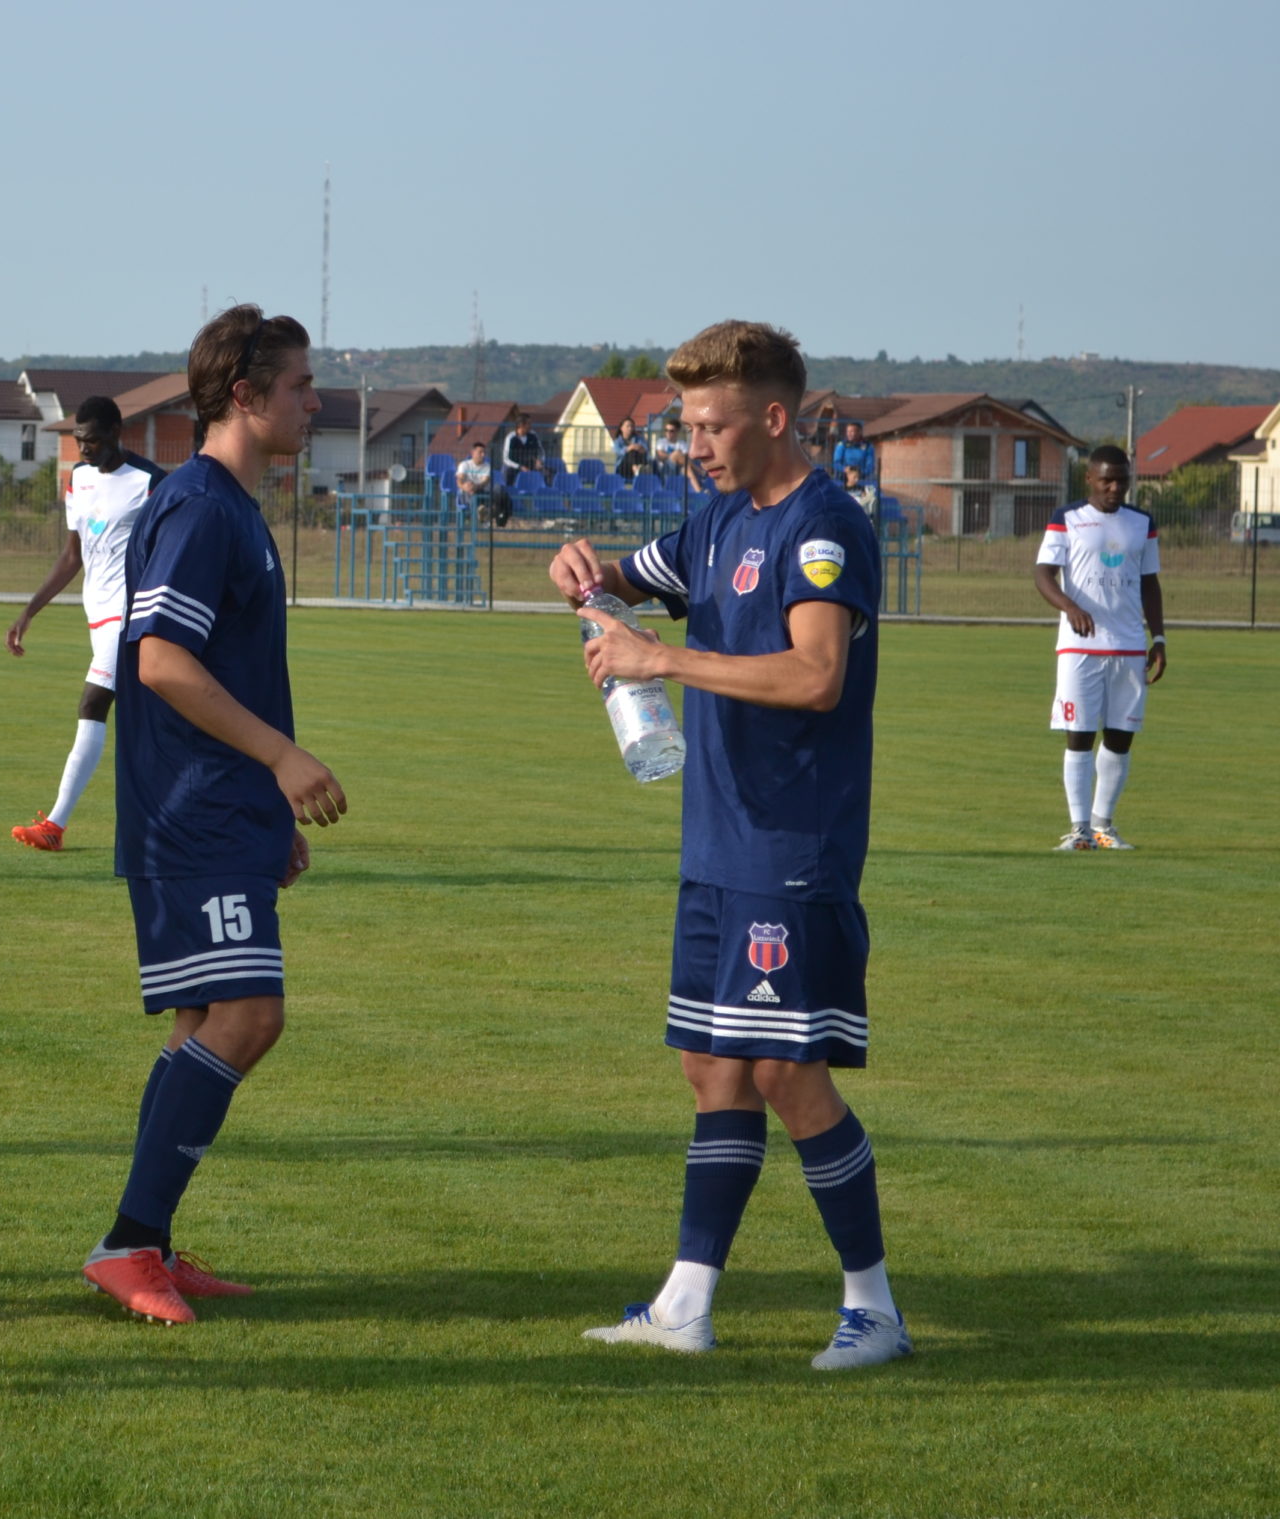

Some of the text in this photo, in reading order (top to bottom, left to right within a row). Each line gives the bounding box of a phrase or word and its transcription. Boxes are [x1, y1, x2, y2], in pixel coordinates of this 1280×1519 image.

[628, 686, 663, 697] WONDER
[201, 894, 253, 943] 15
[747, 993, 781, 1003] adidas
